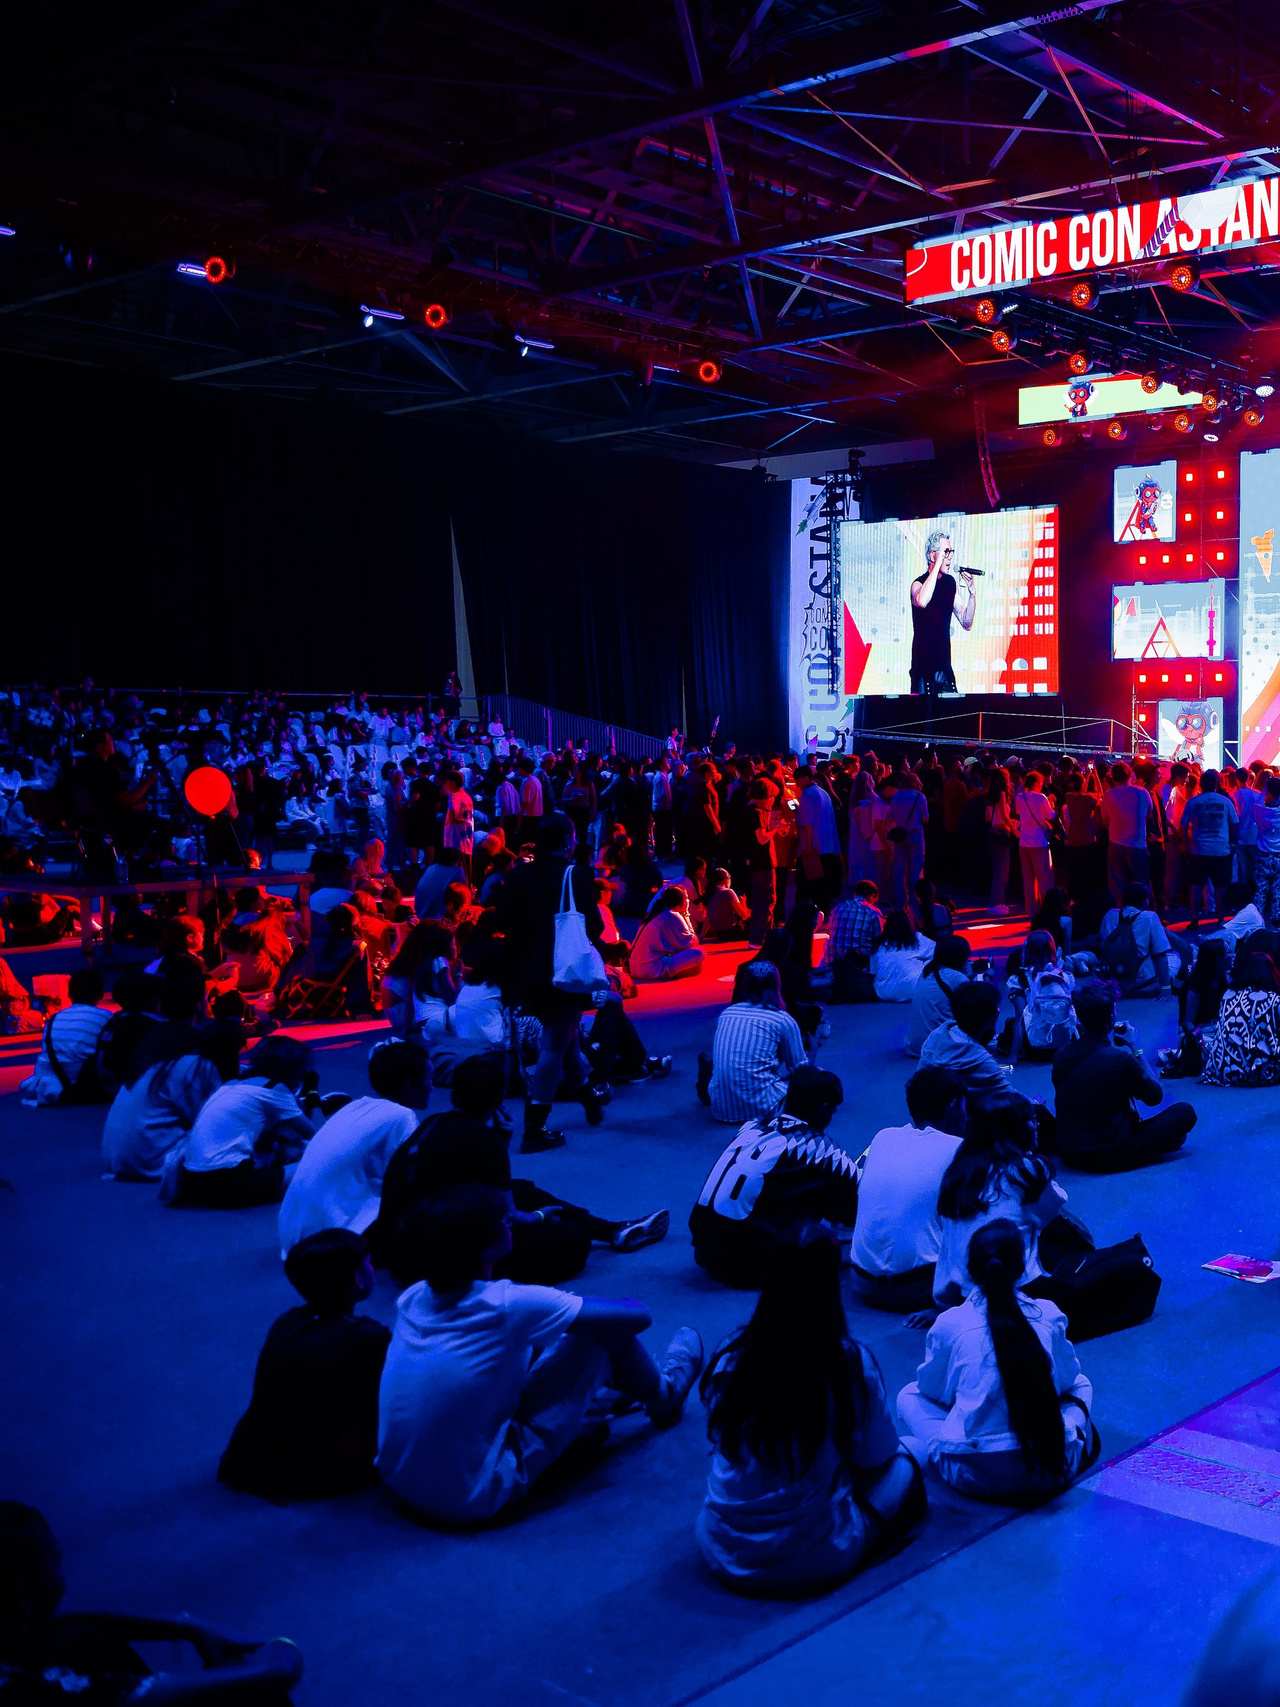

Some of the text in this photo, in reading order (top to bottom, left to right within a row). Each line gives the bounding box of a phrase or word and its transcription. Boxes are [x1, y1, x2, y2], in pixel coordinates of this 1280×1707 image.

[950, 219, 1058, 292] COMIC
[1068, 203, 1141, 268] CON
[809, 626, 830, 651] CO
[698, 1129, 788, 1221] 18
